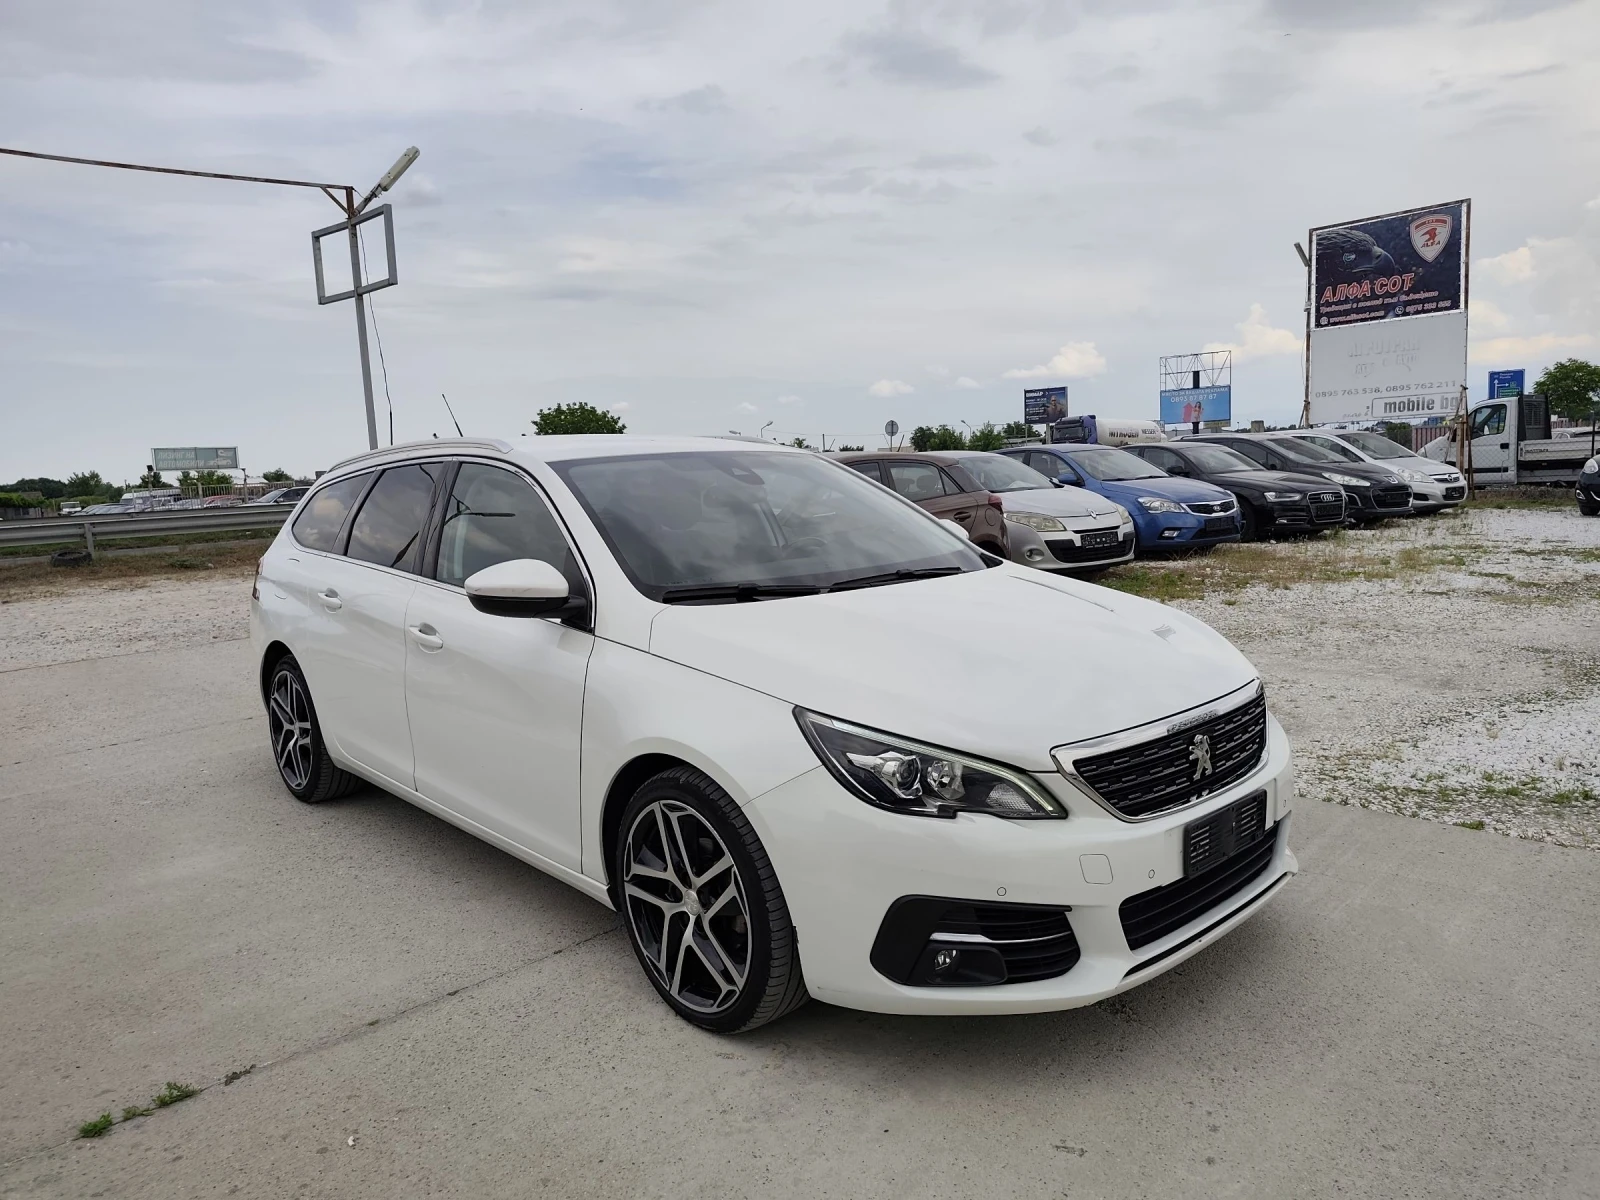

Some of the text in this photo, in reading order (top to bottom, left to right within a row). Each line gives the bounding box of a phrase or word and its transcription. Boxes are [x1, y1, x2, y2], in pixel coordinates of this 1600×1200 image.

[1420, 240, 1441, 248] ALFA
[1320, 273, 1415, 304] АЛФА СОТ
[1315, 390, 1339, 399] 0895
[1341, 388, 1359, 396] 763
[1385, 384, 1411, 392] 0895
[1414, 382, 1434, 390] 762
[1436, 380, 1456, 388] 211
[1383, 397, 1435, 414] mobile
[158, 451, 195, 460] ЛИЗИНГ НА
[158, 459, 205, 468] АВТОМОБИЛИ
